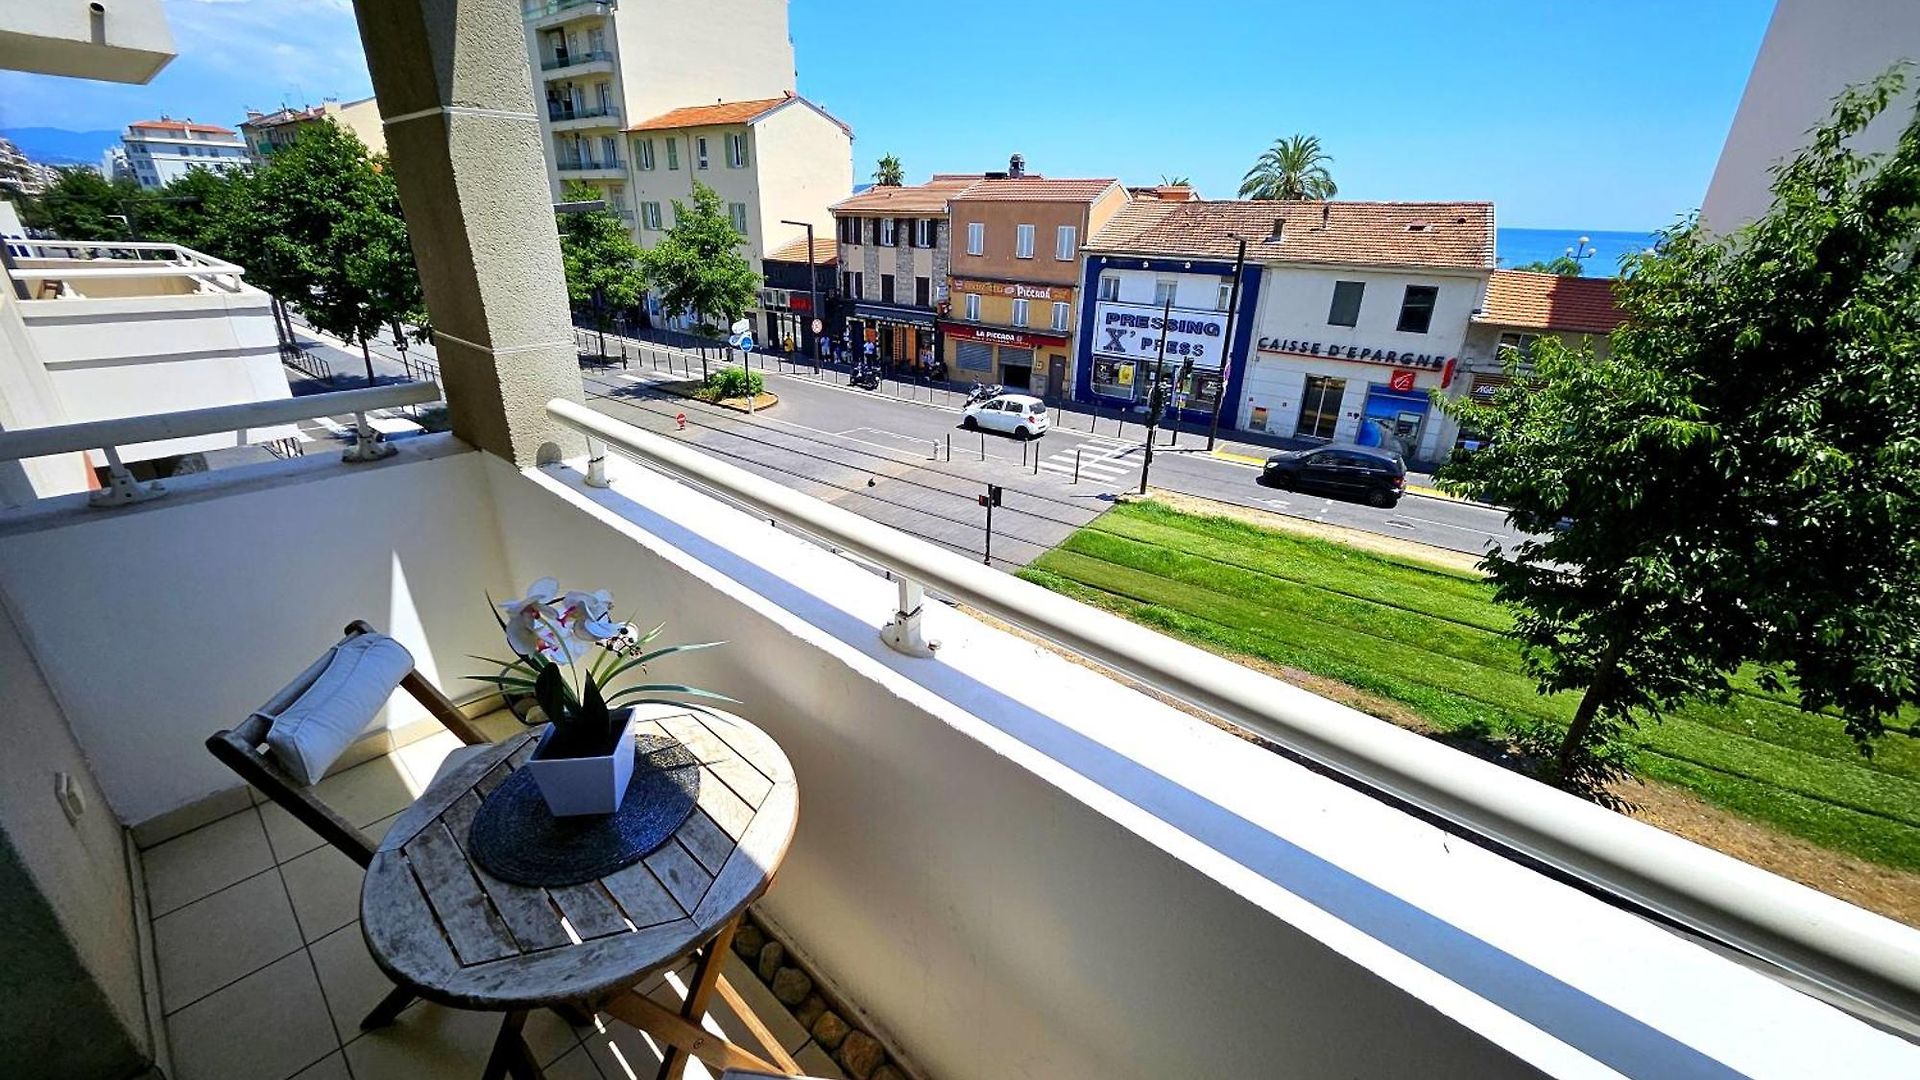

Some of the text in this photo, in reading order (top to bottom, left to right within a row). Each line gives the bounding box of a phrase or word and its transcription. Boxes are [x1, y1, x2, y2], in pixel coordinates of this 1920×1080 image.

[976, 330, 985, 338] LA
[986, 331, 1015, 341] PICCADA
[1105, 312, 1220, 337] PRESSING
[1141, 337, 1204, 357] PRESS
[1258, 337, 1445, 368] CAISSE D'EPARGNE
